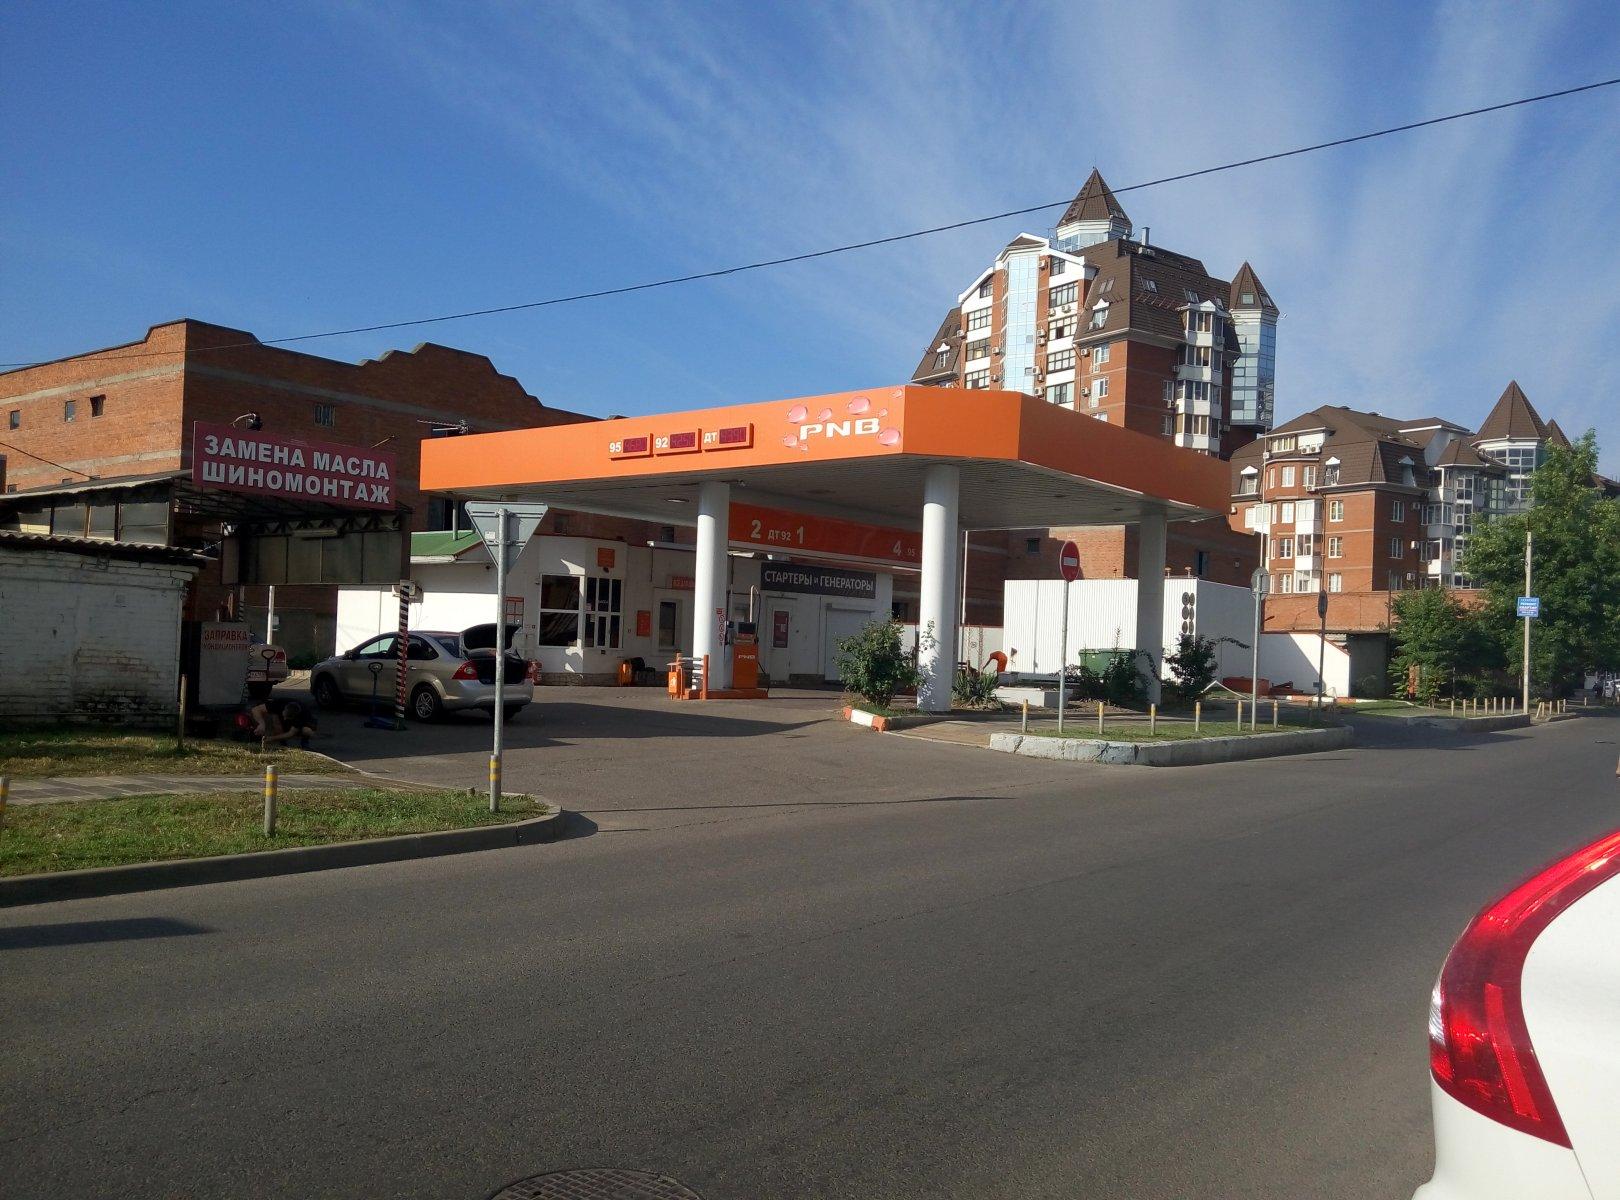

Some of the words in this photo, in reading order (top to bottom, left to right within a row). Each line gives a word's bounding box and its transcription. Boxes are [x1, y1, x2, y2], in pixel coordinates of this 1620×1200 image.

[703, 432, 717, 444] ДТ
[799, 418, 881, 441] PNB
[609, 442, 622, 453] 95
[655, 437, 668, 448] 92
[204, 435, 306, 467] ЗАМЕНА
[313, 451, 390, 480] МАСЛА
[202, 461, 390, 504] ШИНОМОНТАЖ
[751, 520, 761, 539] 2
[797, 526, 804, 544] 1
[764, 570, 813, 586] СТАРТЕРЫ
[819, 575, 874, 592] ГЕНЕРАТОРЫ
[204, 630, 248, 641] ЗАПРАВКА
